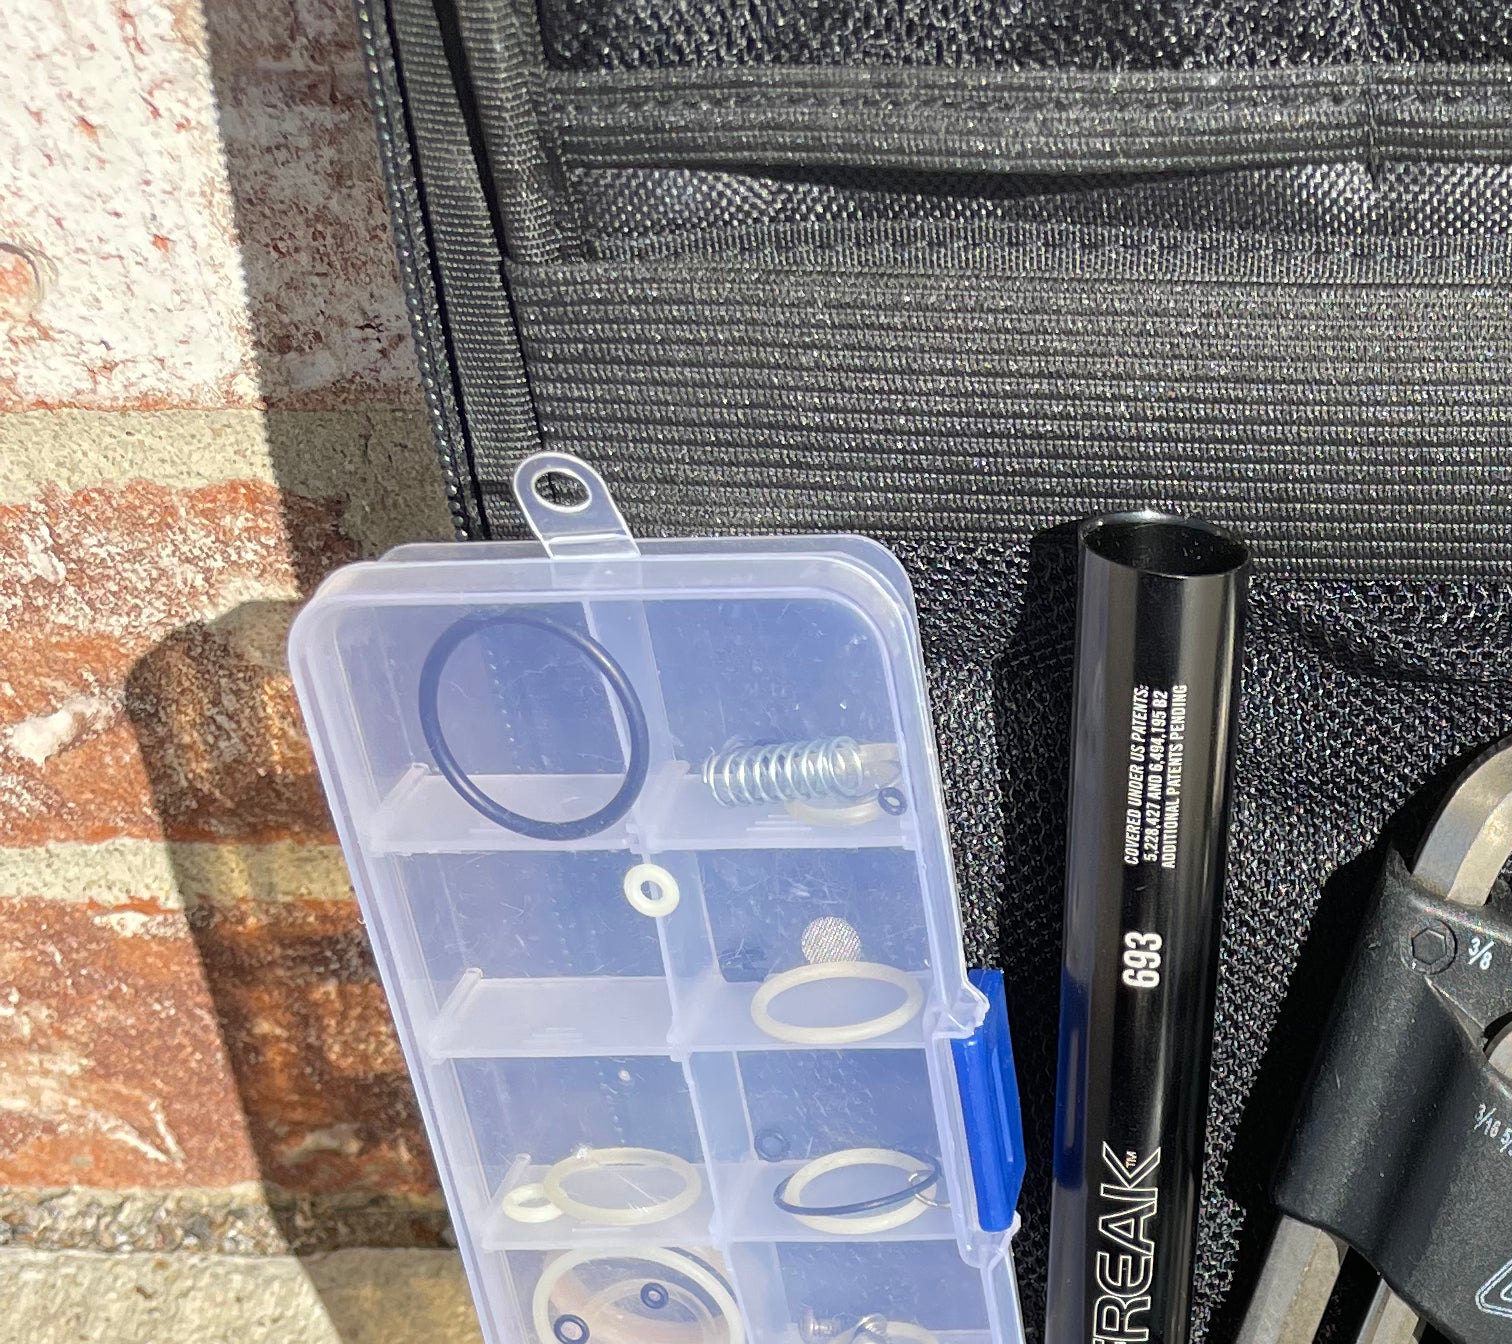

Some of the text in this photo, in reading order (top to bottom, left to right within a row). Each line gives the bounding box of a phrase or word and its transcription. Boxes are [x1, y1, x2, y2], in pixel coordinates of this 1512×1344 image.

[1124, 684, 1149, 865] COVERED UNDER US PATENTS:
[1143, 690, 1168, 861] 5,228,427 AND 6,494,195 B2
[1161, 684, 1188, 869] ADDITIONAL PATENTS PENDING
[1122, 930, 1163, 989] 693
[1468, 937, 1495, 970] 3/8
[1473, 1103, 1501, 1138] 3/16
